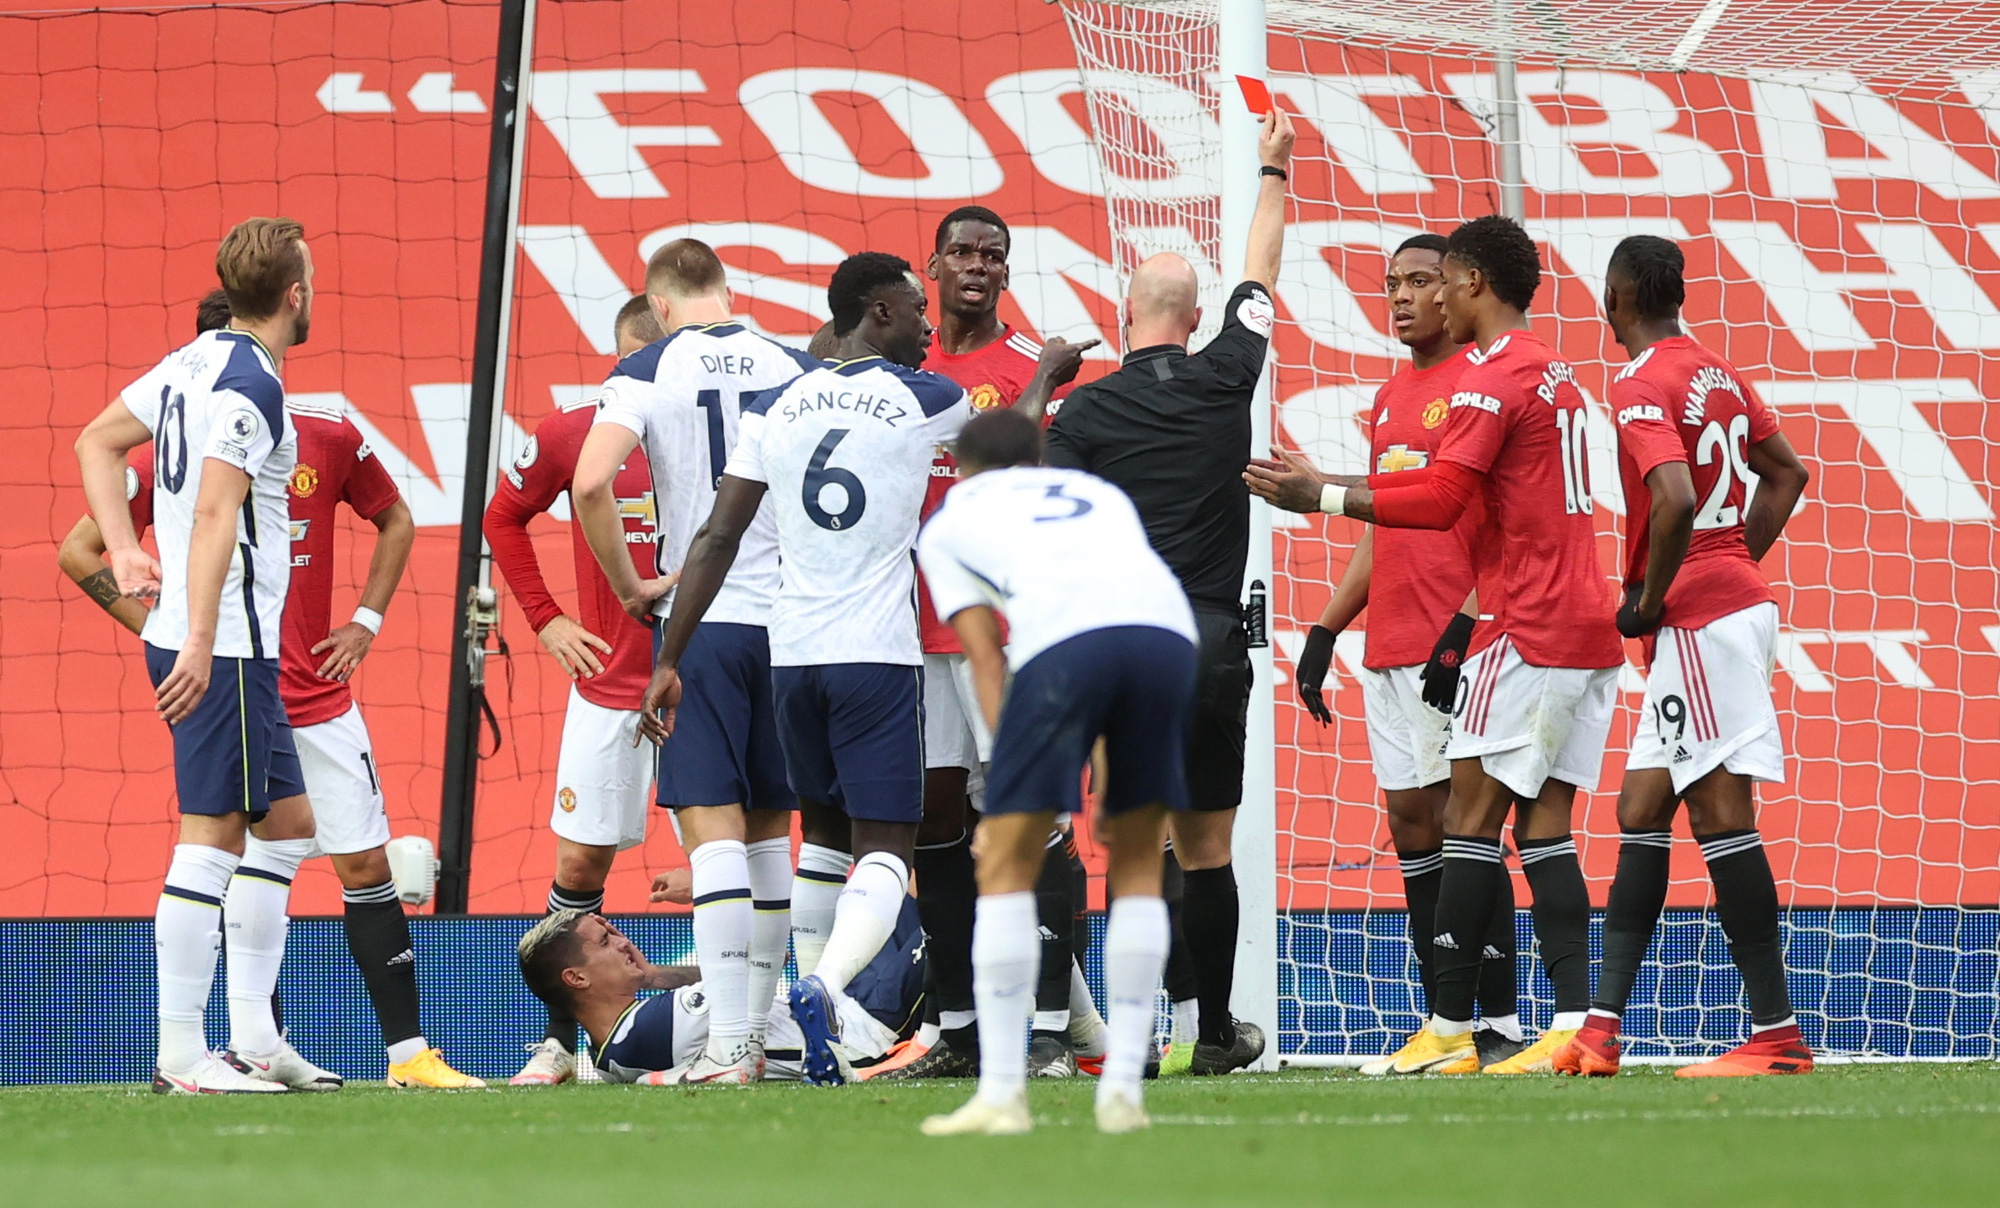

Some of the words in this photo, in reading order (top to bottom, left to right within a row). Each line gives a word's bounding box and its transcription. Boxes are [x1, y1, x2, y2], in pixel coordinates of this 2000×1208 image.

[517, 222, 850, 355] IS
[1005, 217, 2000, 357] NOTH
[700, 354, 754, 377] DIER
[783, 391, 907, 428] SÁNCHEZ
[1616, 404, 1665, 429] OHLER
[155, 384, 188, 495] 10
[802, 428, 867, 532] 6
[1556, 408, 1593, 515] 10
[1693, 413, 1749, 530] 29
[1032, 484, 1094, 523] 3
[721, 950, 748, 959] SPURS
[750, 960, 772, 970] URS
